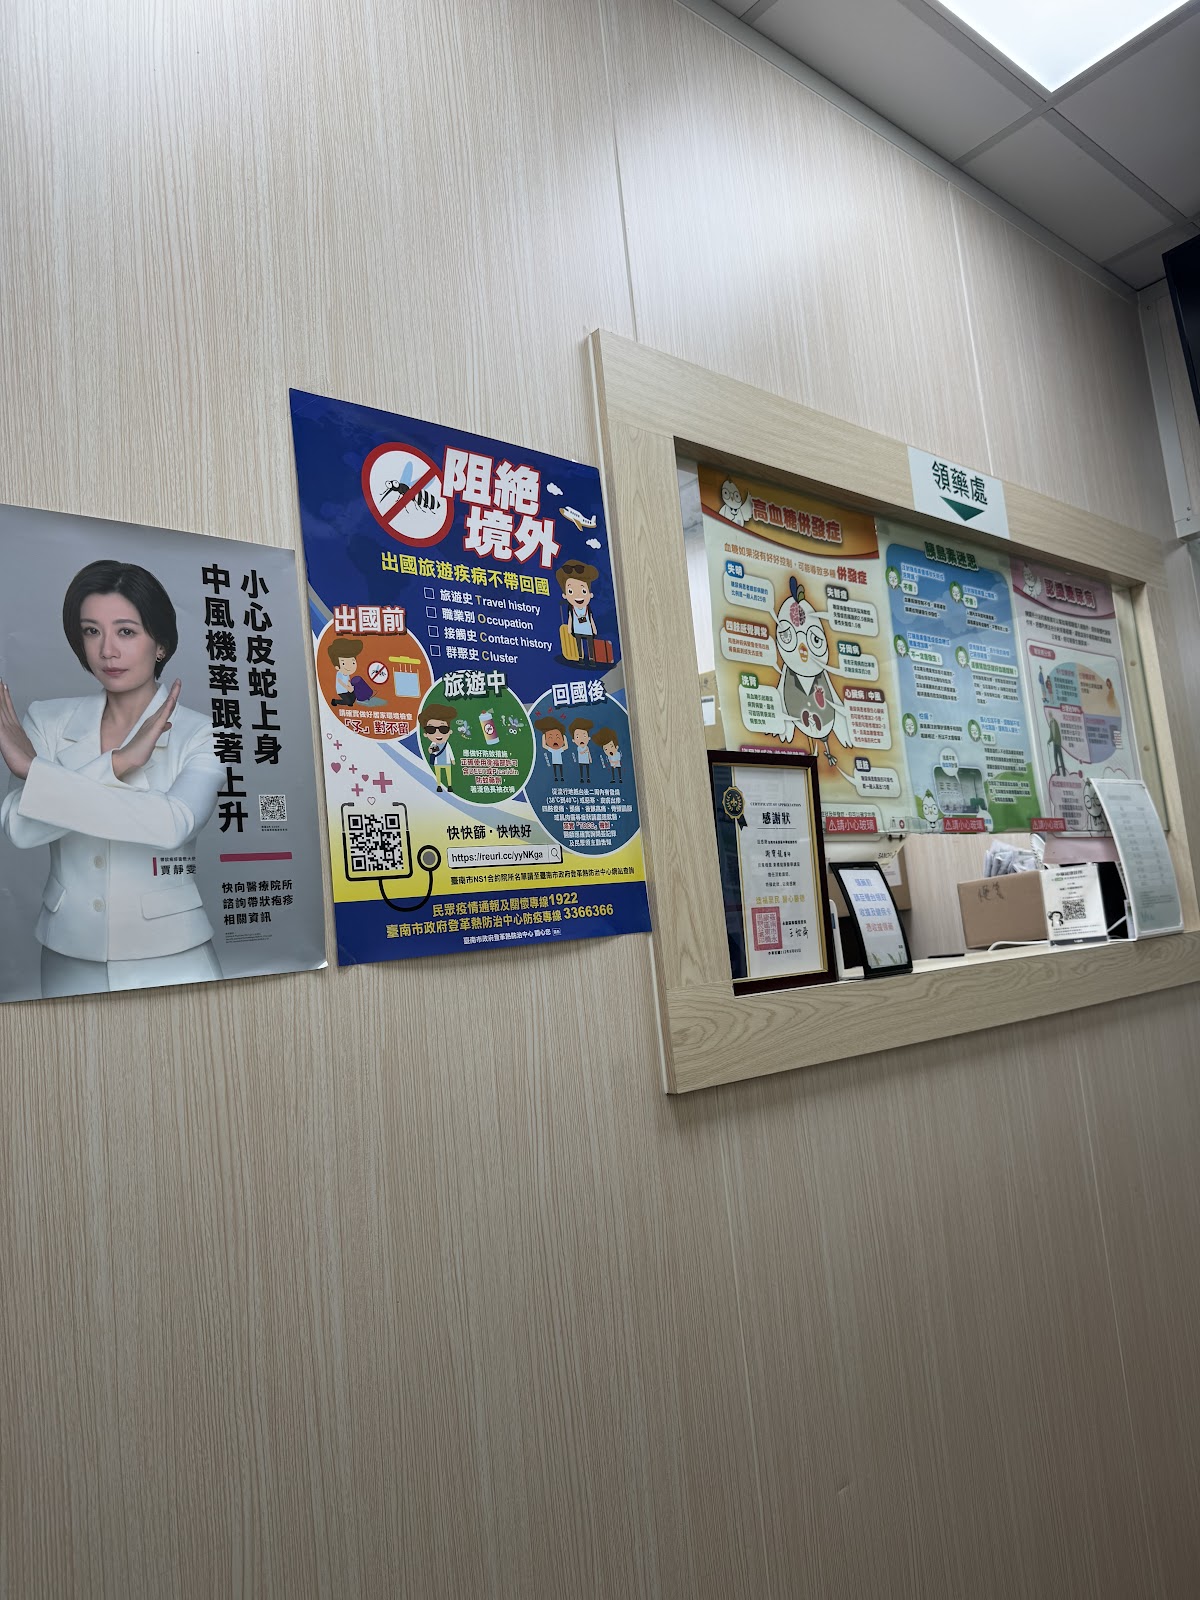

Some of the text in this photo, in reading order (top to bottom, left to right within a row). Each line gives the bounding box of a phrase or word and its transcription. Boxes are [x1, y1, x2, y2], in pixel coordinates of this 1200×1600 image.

[442, 446, 541, 517] 阻絕
[931, 460, 988, 506] 領藥處
[750, 498, 843, 544] 高血糖併發症
[464, 505, 561, 569] 境外
[381, 552, 551, 597] 出國旅遊疾病不帶回國
[727, 562, 743, 576] 失明
[836, 566, 868, 585] 併發症
[440, 589, 541, 616] 旅遊史 Travel history
[826, 586, 848, 600] 失智症
[333, 605, 406, 634] 出國前
[442, 608, 534, 632] 職業別 Occupation
[725, 620, 768, 638] 四肢感覺異常
[444, 626, 553, 652] 接觸史 Contact history
[446, 645, 519, 665] 群聚史 Cluster
[838, 643, 861, 657] 牙周病
[241, 568, 283, 766] 小心皮蛇上身
[443, 671, 507, 698] 旅遊中
[741, 675, 757, 687] 洗腎
[201, 562, 248, 834] 中風機率跟著上升
[551, 680, 606, 706] 回國後
[844, 688, 882, 702] 心臟病 中風
[762, 811, 791, 825] 感謝狀
[836, 819, 875, 831] 請小心玻璃
[450, 849, 544, 864] https://reurl.cc/yyNKga
[160, 863, 197, 877] 賈靜雯
[221, 879, 293, 894] 快向醫療院所
[222, 894, 295, 910] 諮詢帶狀疱疹
[223, 911, 272, 926] 相關資訊
[385, 904, 614, 940] 臺南市政府登革熱防治中心防疫專線 3366366
